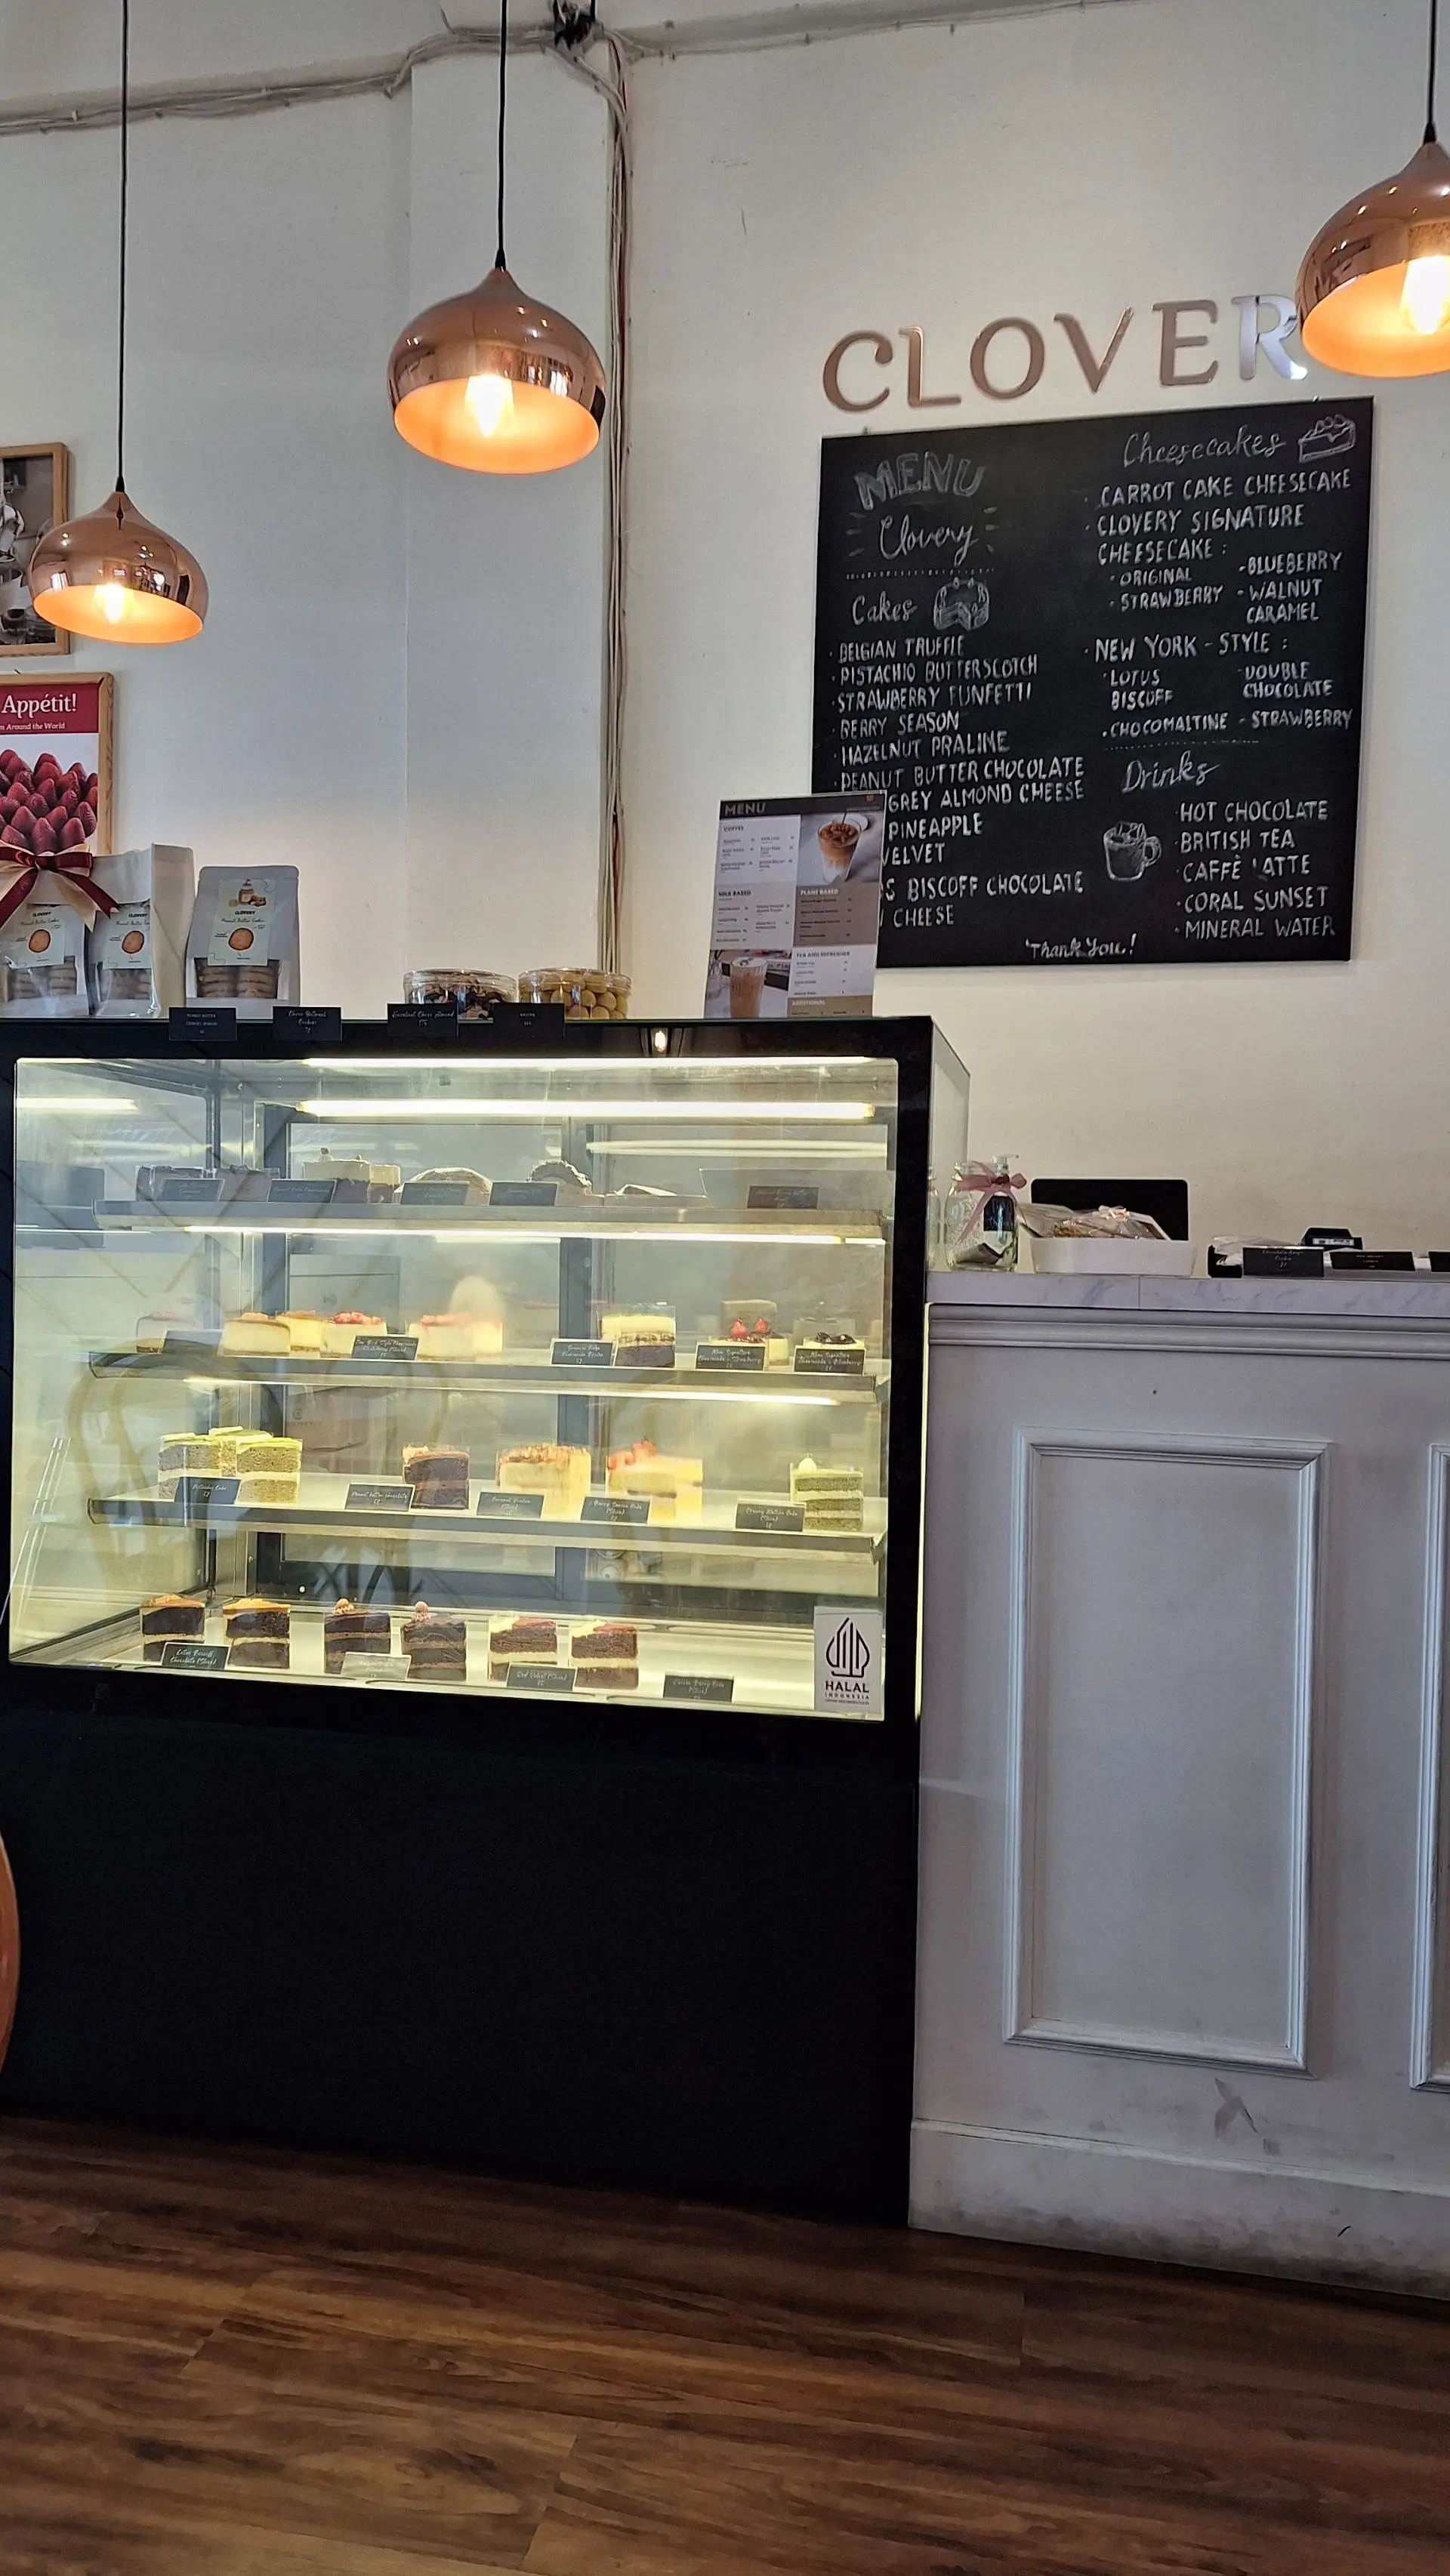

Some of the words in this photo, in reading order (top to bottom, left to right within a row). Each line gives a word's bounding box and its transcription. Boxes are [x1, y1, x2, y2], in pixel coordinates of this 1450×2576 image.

[1124, 425, 1286, 468] Cheesecakes
[854, 451, 986, 510] MENU
[1100, 481, 1175, 508] CARROT
[1183, 476, 1233, 501] CAKE
[1245, 468, 1351, 498] CHEESECAKE
[1097, 509, 1182, 537] CLOVERY
[1190, 504, 1305, 535] SIGNATURE
[880, 514, 980, 566] Clovery
[1098, 538, 1214, 566] CHEESECAKE
[1248, 550, 1343, 575] BLUEBERRY
[1119, 567, 1192, 587] ORIGINAL
[1249, 578, 1322, 602] WALNUT
[853, 590, 918, 625] Cakes
[1121, 585, 1223, 612] STRAWBERRY
[1246, 602, 1319, 624] CARAMEL
[839, 639, 896, 664] BELGIAN
[905, 635, 964, 657] TRUFFLE
[1095, 637, 1136, 663] NEW
[1144, 634, 1199, 659] YORK
[1219, 631, 1270, 655] STYLE
[841, 662, 916, 686] PISTACHIO
[925, 654, 1038, 683] BUTTERSCOTCH
[1110, 668, 1161, 687] LOTUS
[1245, 661, 1311, 681] DOUBLE
[838, 686, 941, 713] STRAWBERRY
[949, 682, 1032, 707] FUNFETTI
[1111, 689, 1174, 711] BISCOFF
[1243, 679, 1334, 699] CHOCOLATE
[1, 692, 77, 718] Appétit!
[1251, 707, 1353, 729] STRAWBERRY
[841, 716, 887, 739] BERRY
[897, 710, 960, 735] SEASON
[1110, 712, 1229, 738] CHOCOMALTINE
[842, 738, 921, 767] HAZELNUT
[932, 730, 1011, 757] PRALINE
[841, 767, 905, 792] PEANUT
[914, 760, 978, 787] BUTTER
[984, 756, 1084, 780] CHOCOLATE
[1121, 750, 1220, 793] Drinks
[725, 802, 766, 815] MENU
[888, 790, 932, 813] GREY
[940, 783, 1012, 809] ALMOND
[1020, 779, 1084, 803] CHEESE
[1180, 801, 1217, 823] HOT
[1225, 799, 1328, 823] CHOCOLATE
[888, 812, 983, 841] PINEAPPLE
[1180, 829, 1251, 854] BRITISH
[1260, 828, 1296, 849] TEA
[908, 874, 979, 902] BISCOFF
[986, 870, 1084, 896] CHOCOLATE
[1185, 890, 1245, 914] CORAL
[1253, 886, 1328, 912] SUNSET
[893, 904, 954, 927] CHEESE
[1185, 917, 1264, 939] MINERAL
[1275, 915, 1336, 937] WATER
[1026, 937, 1081, 960] Thank
[825, 1681, 869, 1693] HALAL
